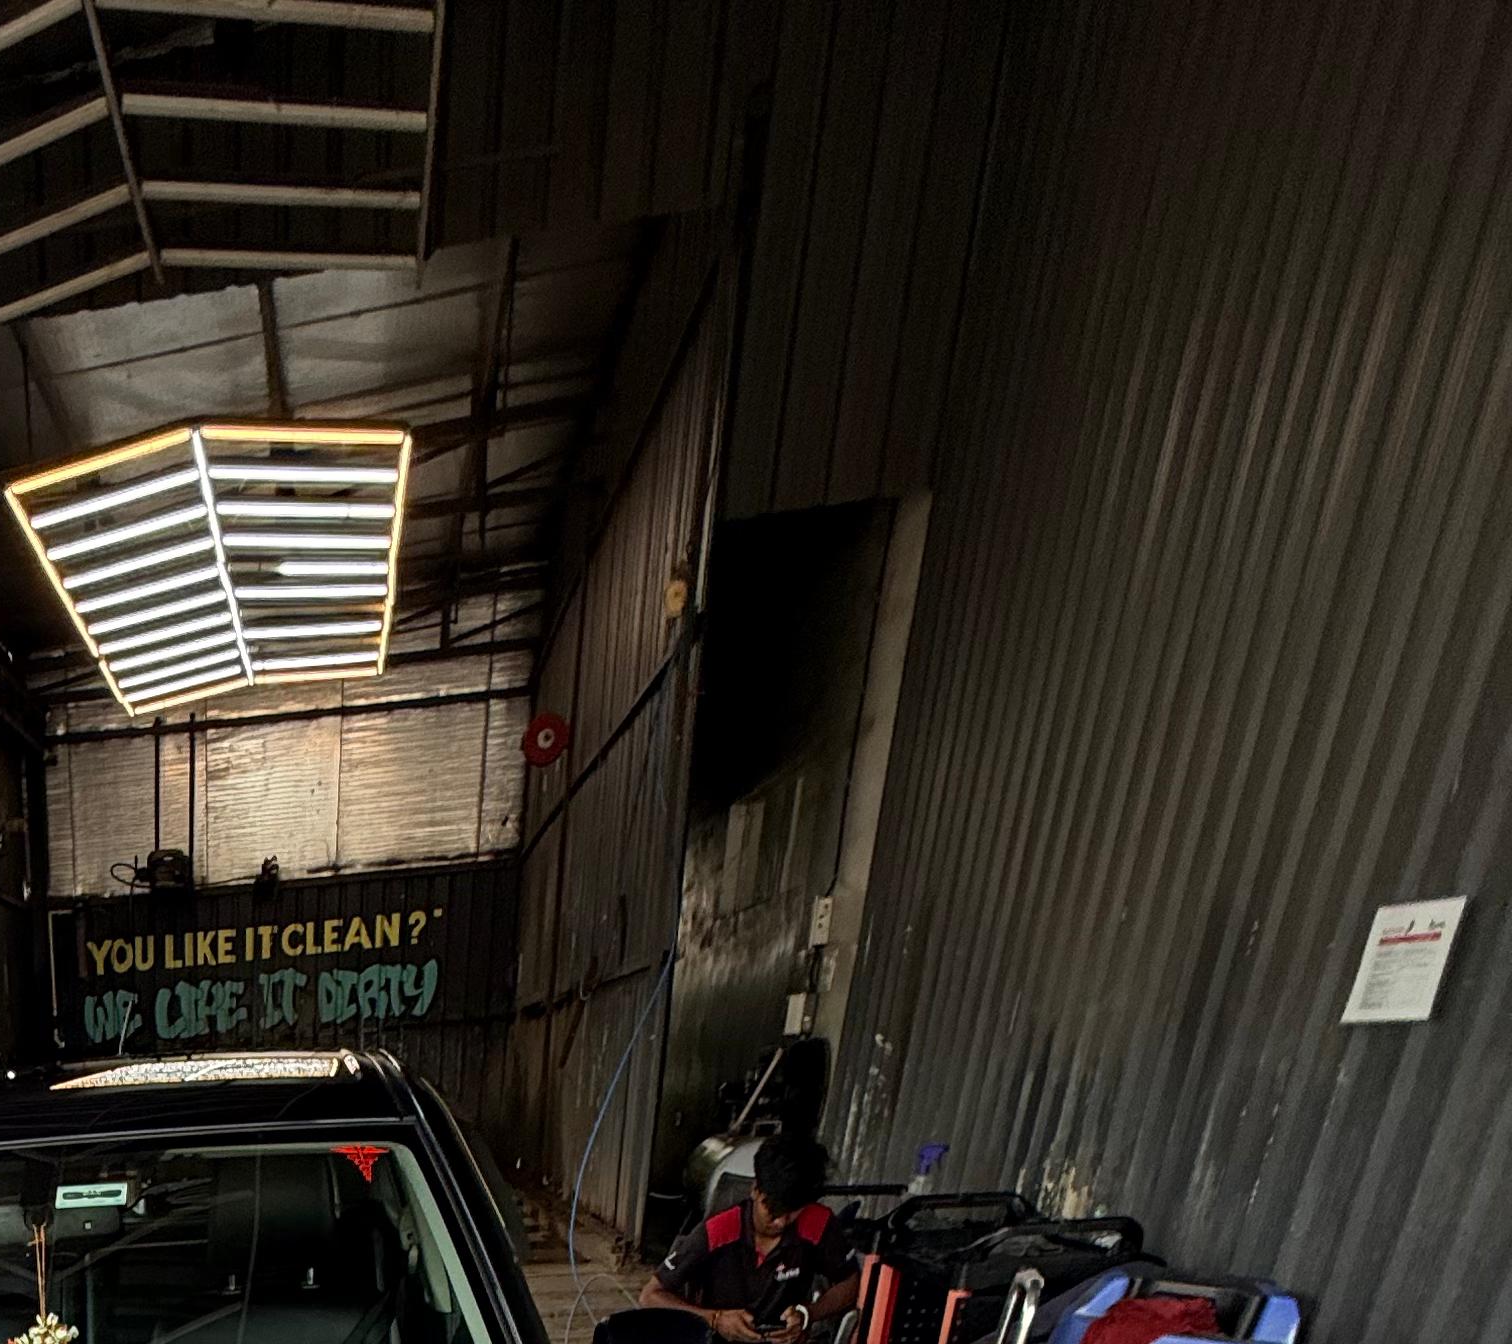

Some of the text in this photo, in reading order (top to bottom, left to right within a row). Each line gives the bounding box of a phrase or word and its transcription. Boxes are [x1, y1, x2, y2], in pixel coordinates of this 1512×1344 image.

[86, 935, 155, 976] YOU
[164, 928, 237, 970] LIKE
[245, 925, 278, 962] IT
[84, 958, 438, 1043] WE LIKE IT DIRTY
